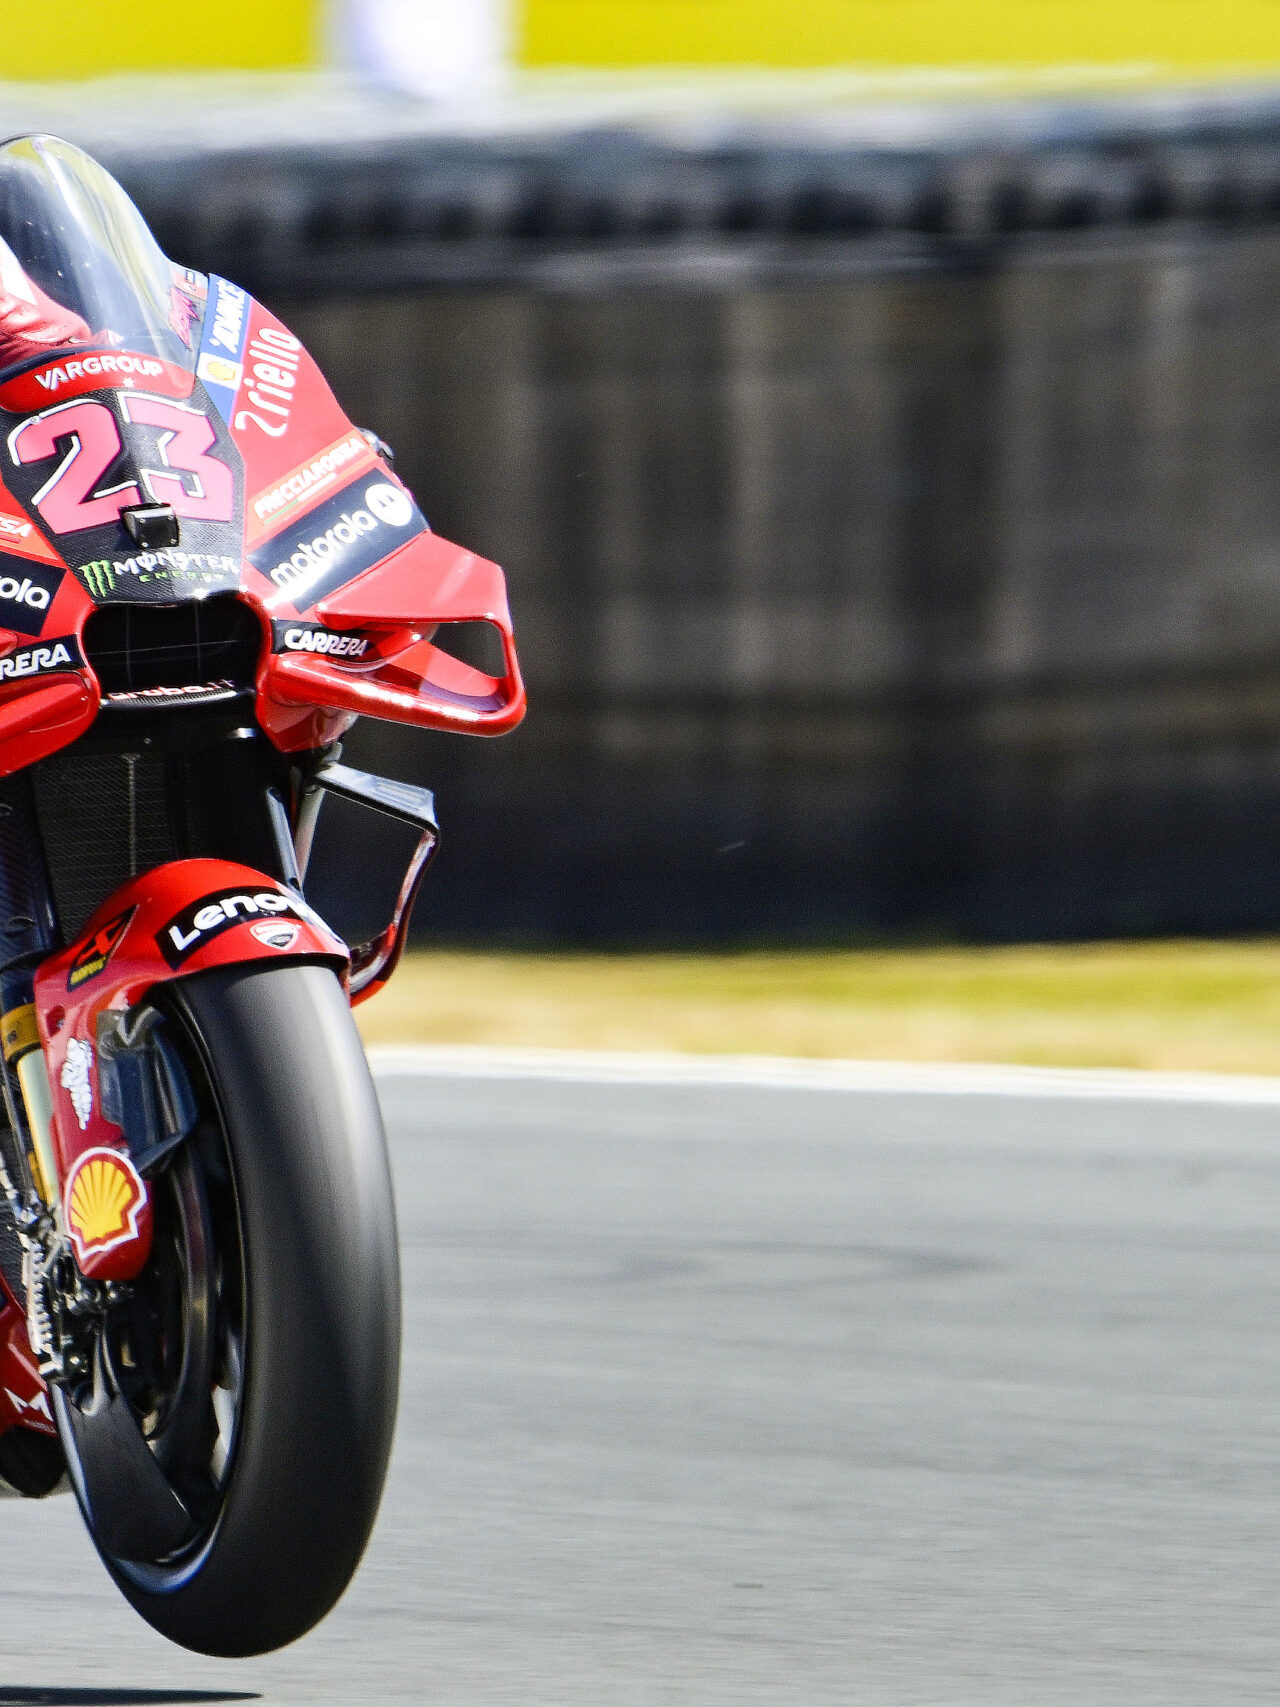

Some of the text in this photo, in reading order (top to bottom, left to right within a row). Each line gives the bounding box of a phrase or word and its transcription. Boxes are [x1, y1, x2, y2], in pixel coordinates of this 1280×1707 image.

[7, 391, 234, 535] 23
[253, 437, 366, 519] FRECCIAROSSA
[112, 548, 240, 576] MONSTER
[270, 510, 379, 590] motorola
[284, 629, 368, 656] CARRERA
[168, 893, 312, 951] Leno
